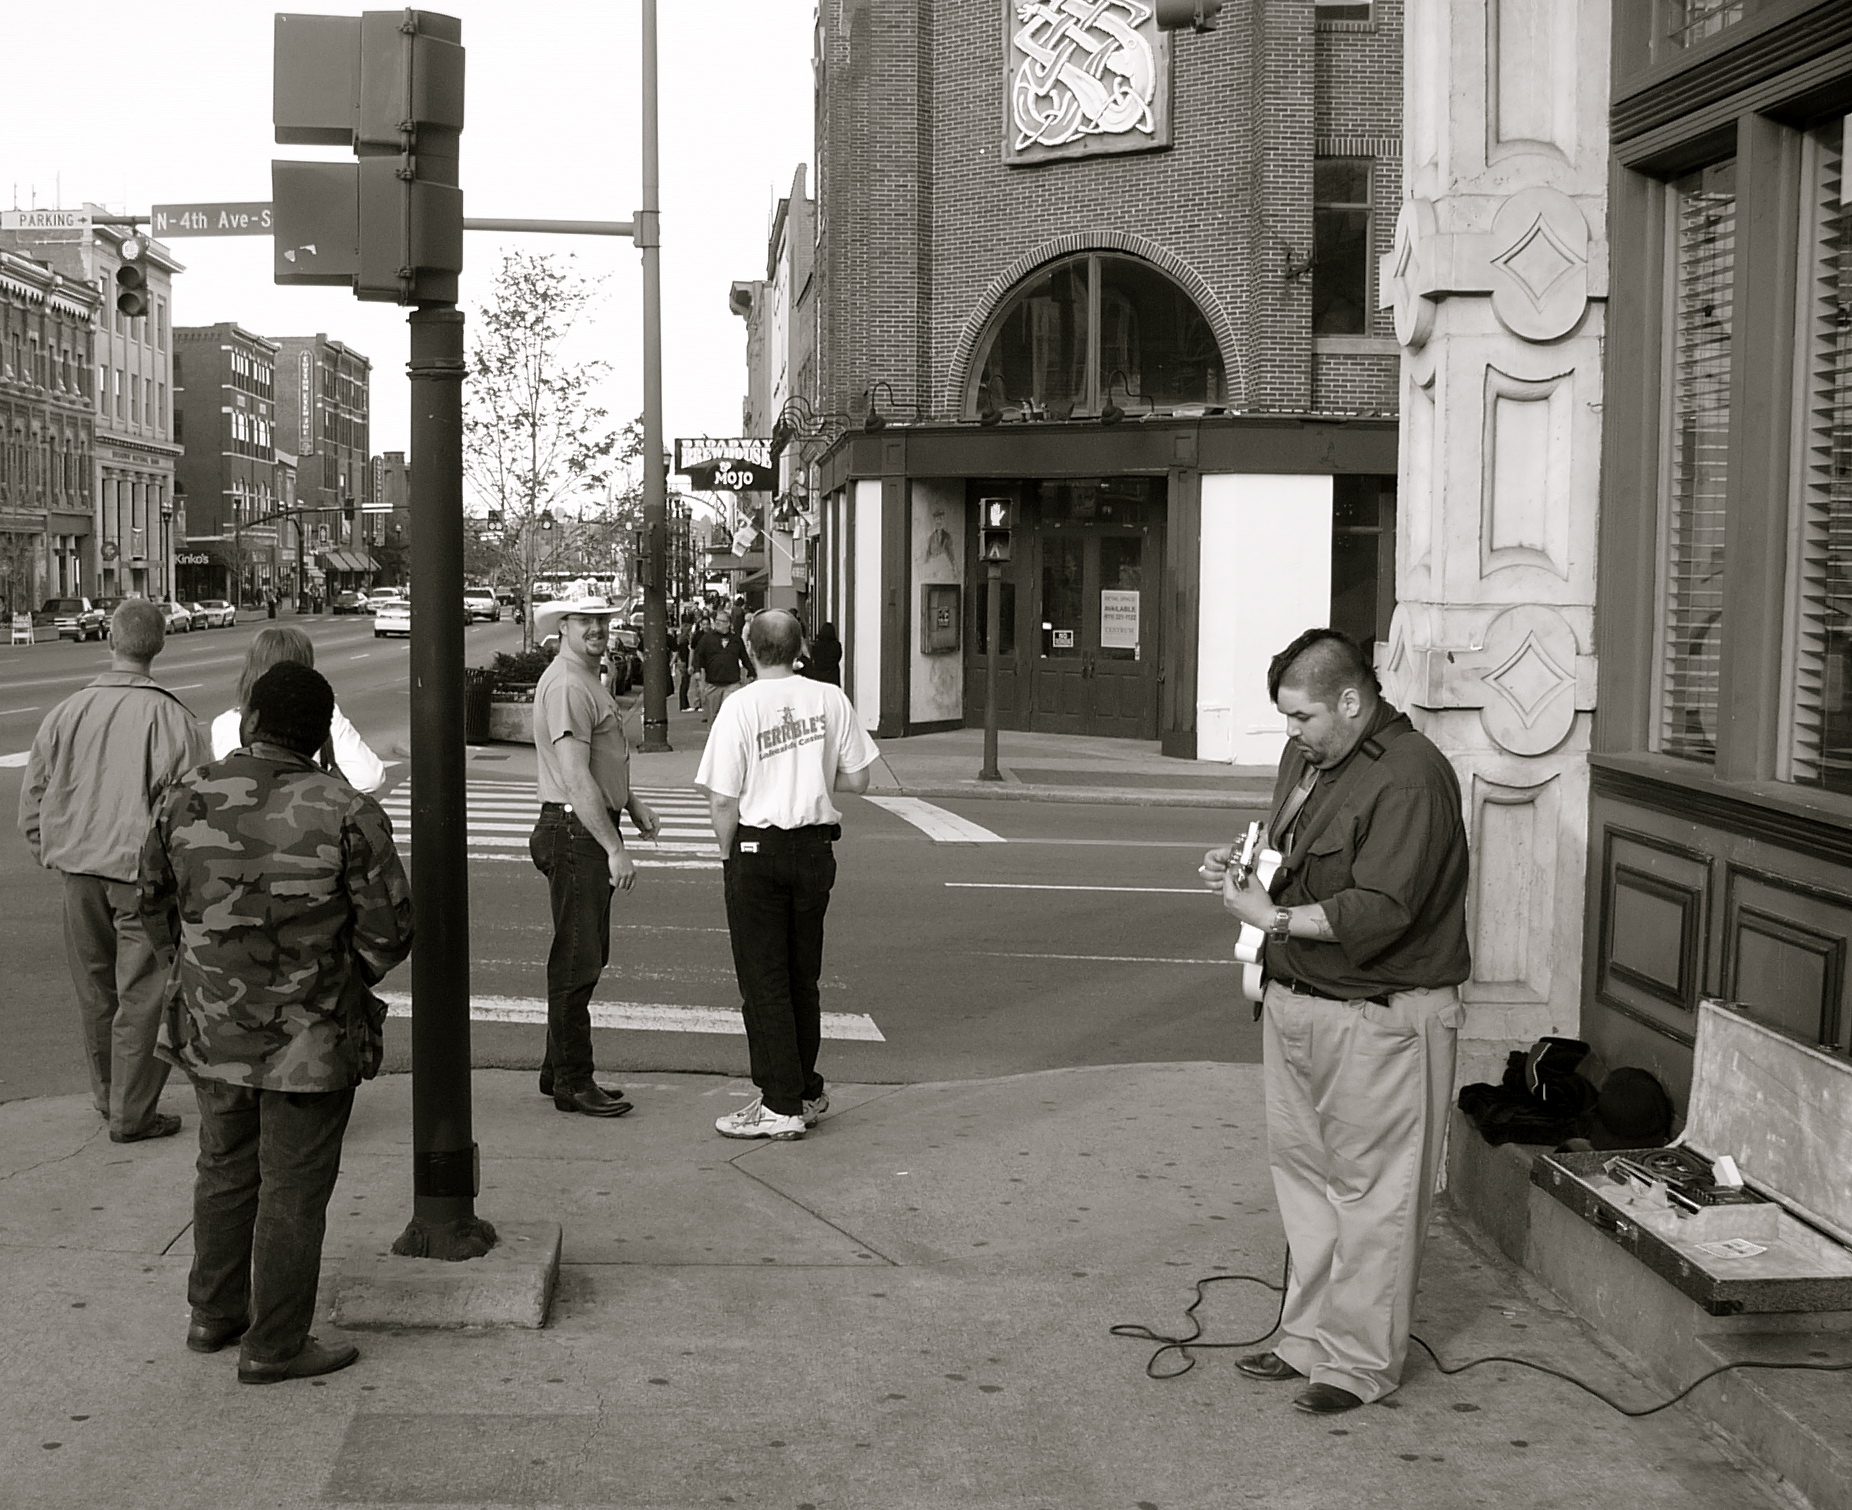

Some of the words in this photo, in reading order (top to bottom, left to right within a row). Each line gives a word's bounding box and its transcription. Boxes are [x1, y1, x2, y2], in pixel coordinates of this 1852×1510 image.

[19, 214, 74, 227] PARKING
[681, 447, 773, 470] BREWHOUSE
[714, 471, 754, 490] MOJO
[174, 552, 209, 565] Kinko's
